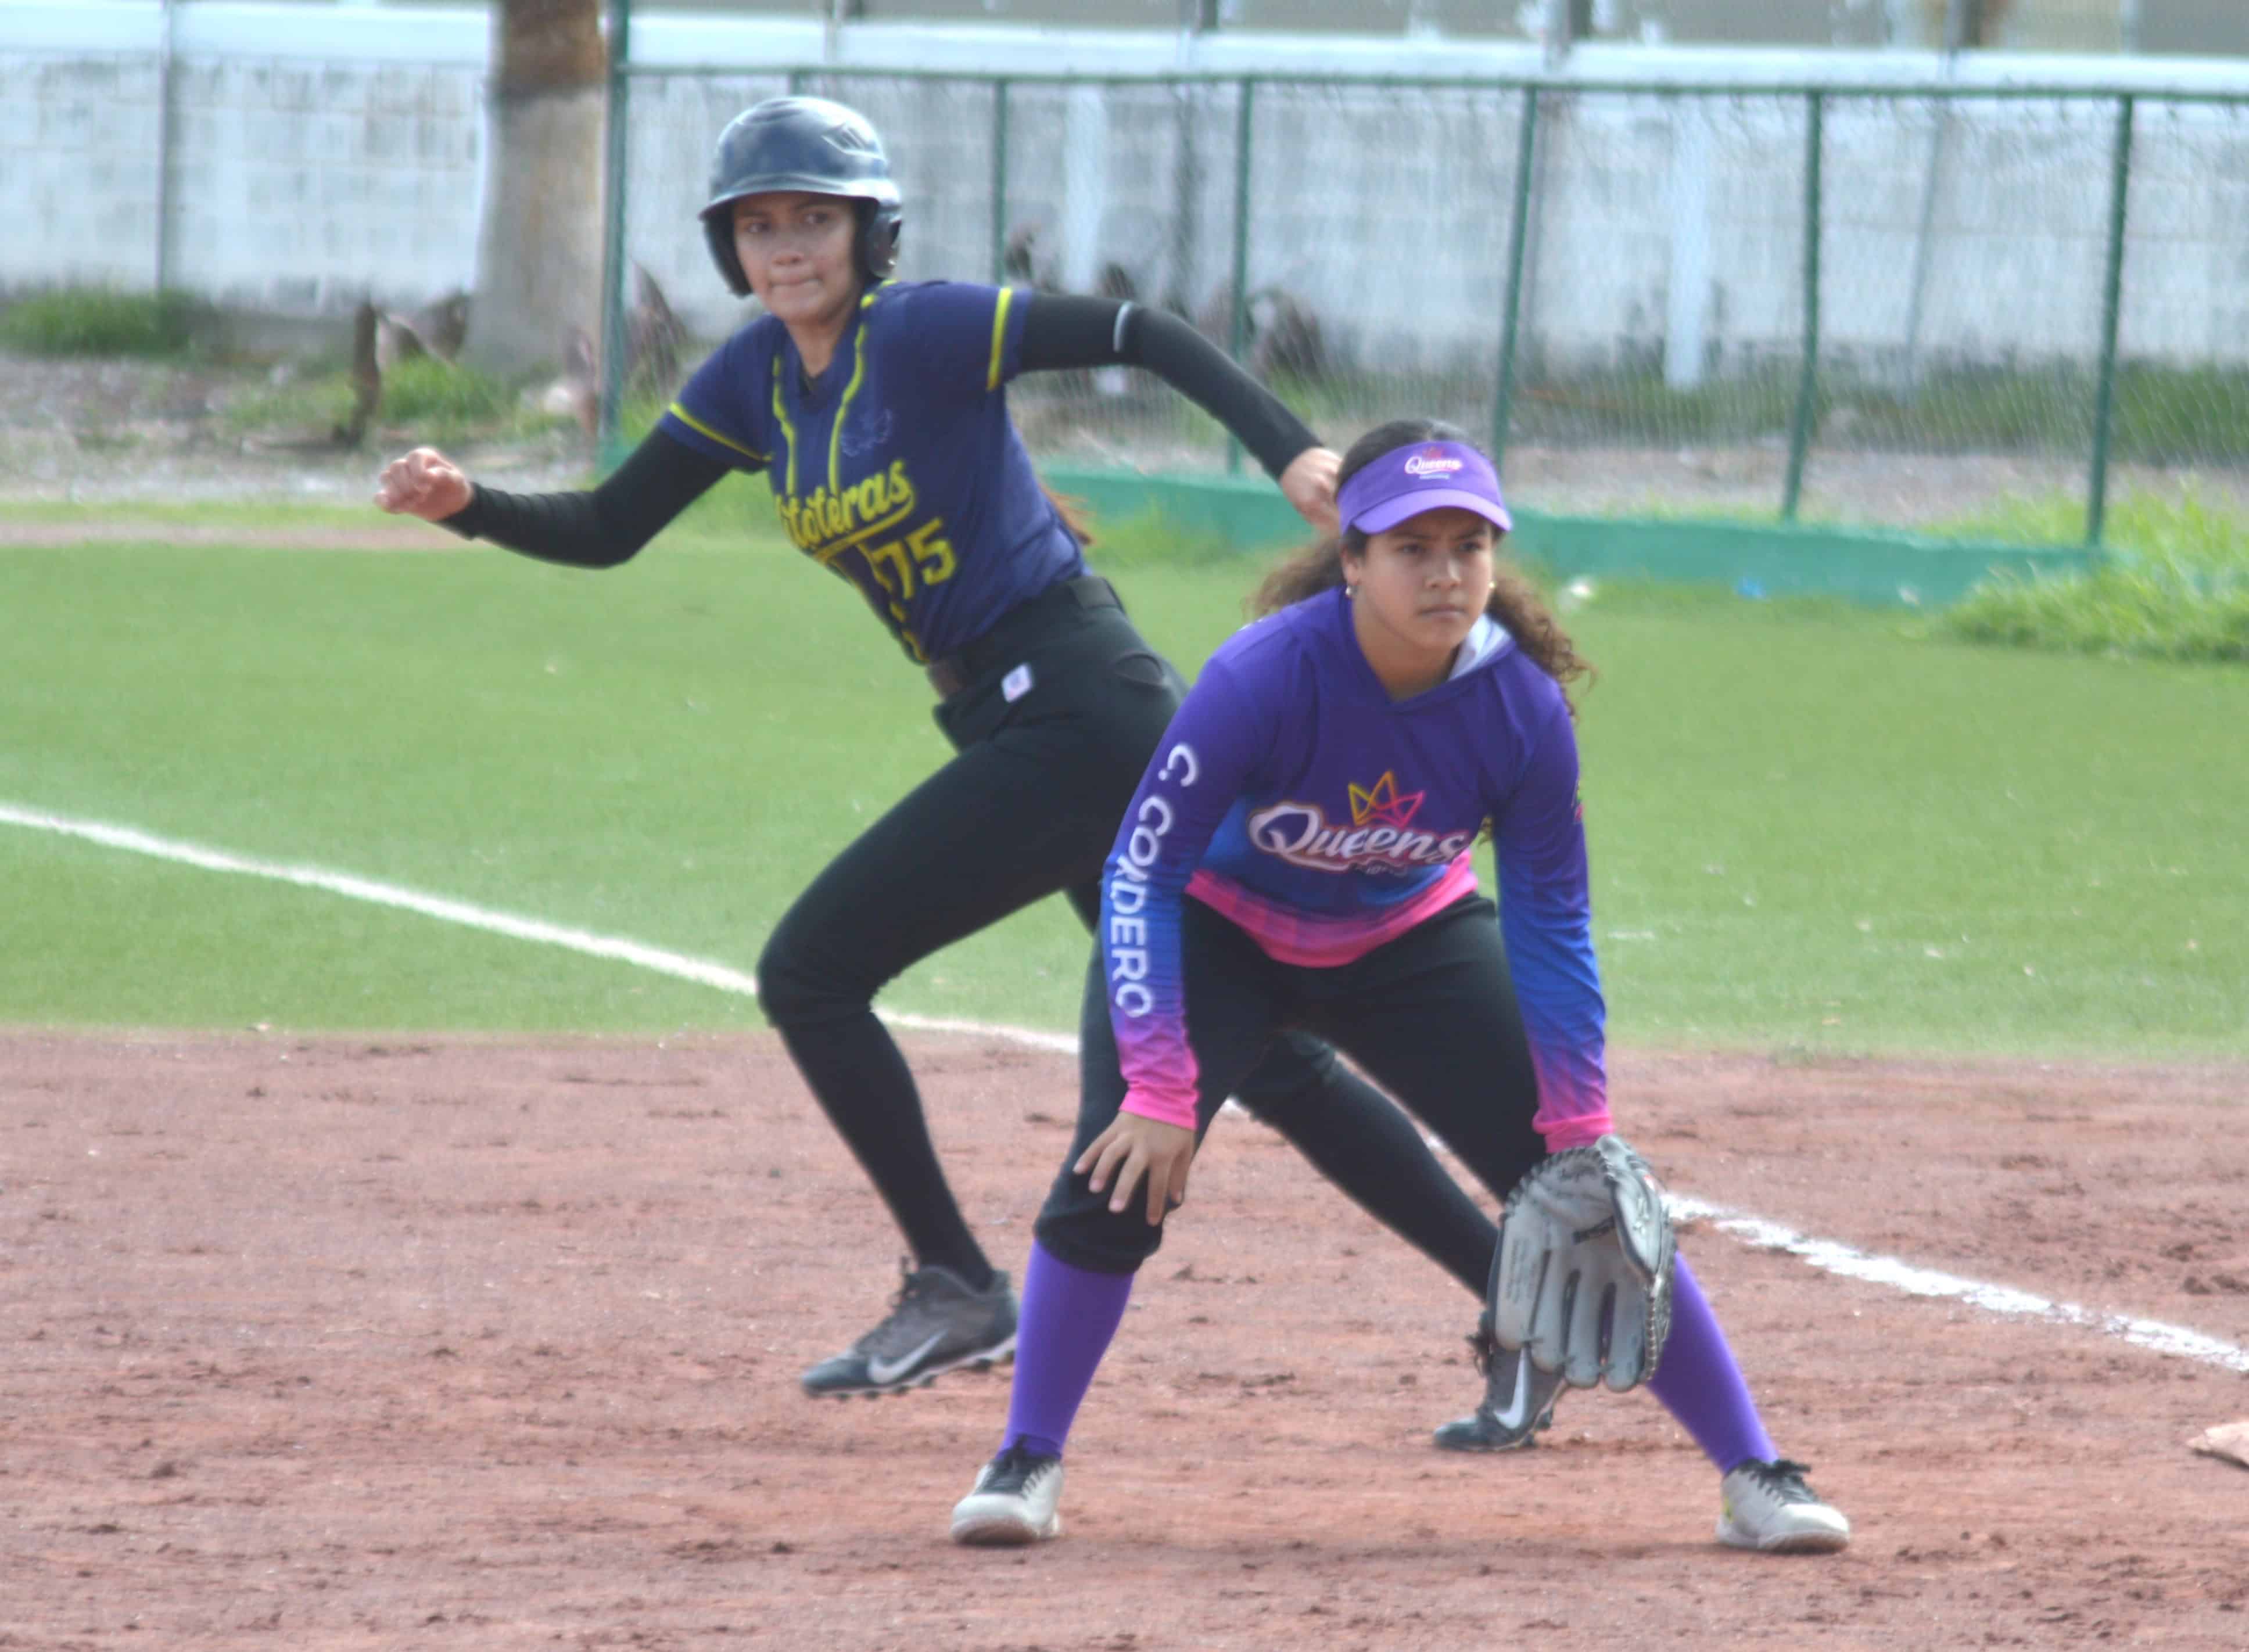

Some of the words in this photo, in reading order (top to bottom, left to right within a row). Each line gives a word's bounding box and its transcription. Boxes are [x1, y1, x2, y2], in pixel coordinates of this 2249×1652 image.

[1404, 456, 1462, 474] Queens
[871, 517, 956, 599] 75
[1158, 743, 1198, 788] C.
[1248, 800, 1471, 871] Queens
